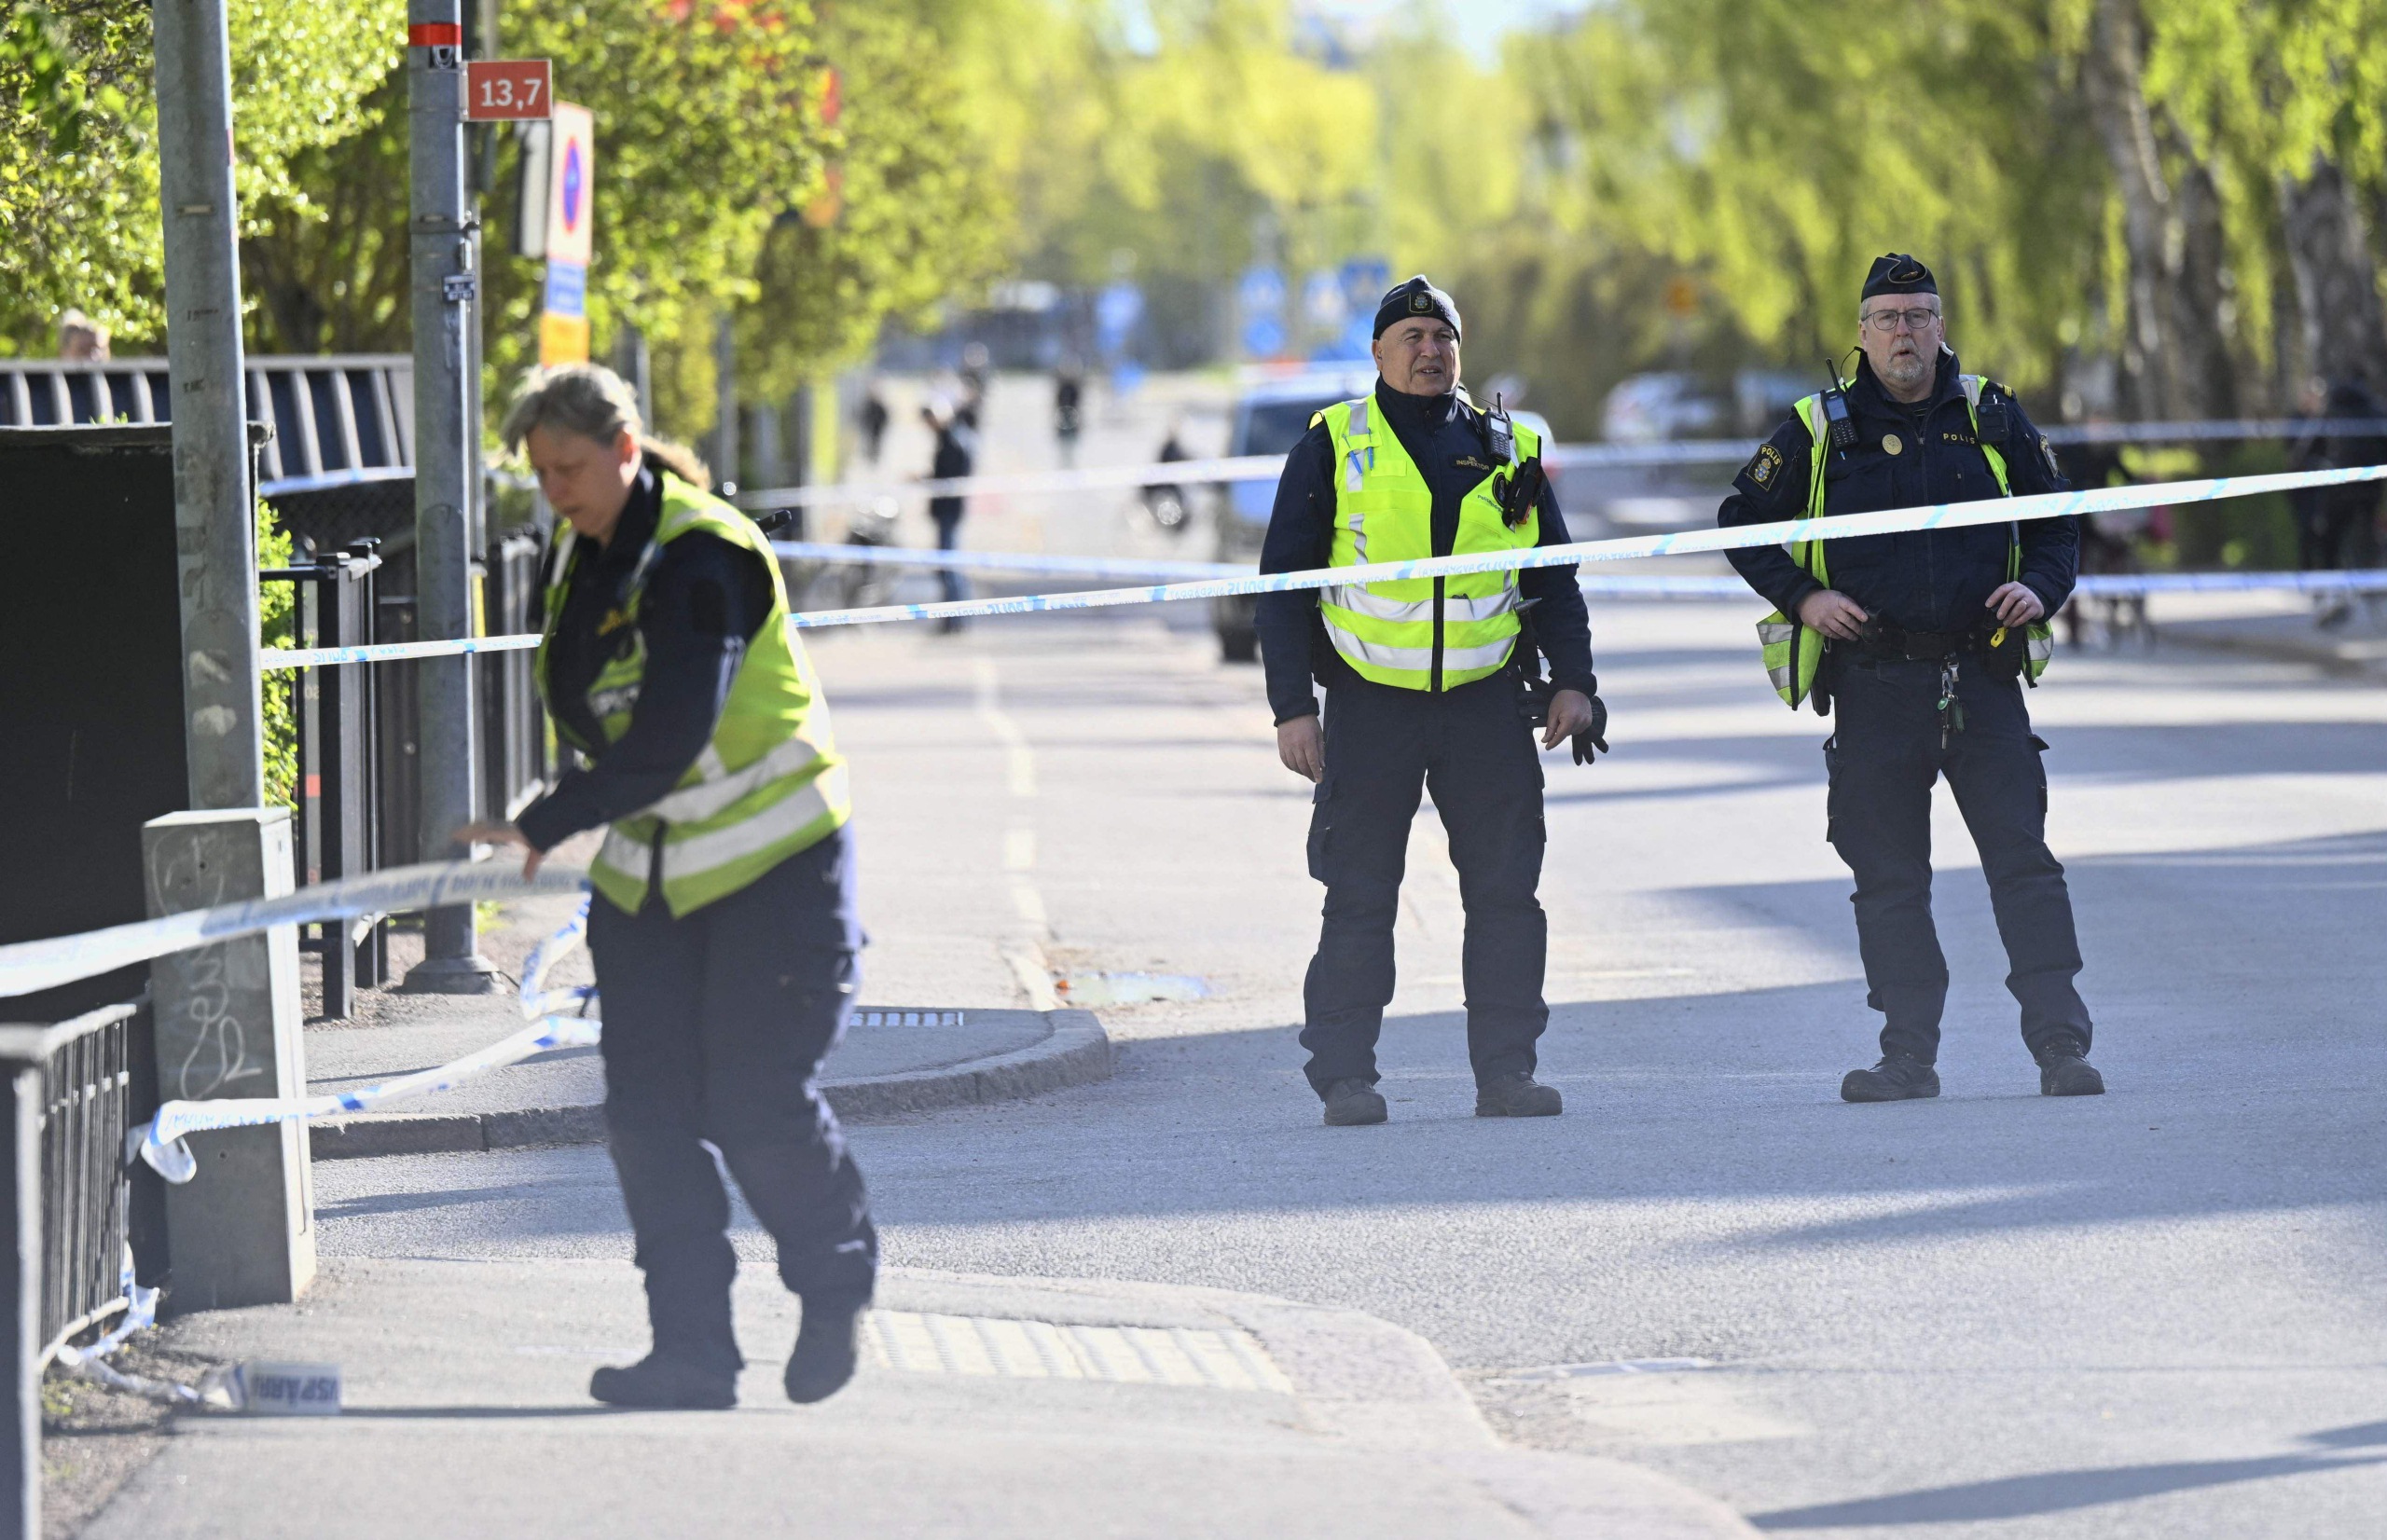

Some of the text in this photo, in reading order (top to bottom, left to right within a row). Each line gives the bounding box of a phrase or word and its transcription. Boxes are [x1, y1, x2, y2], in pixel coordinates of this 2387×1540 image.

[480, 78, 542, 111] 13,7
[1942, 433, 1976, 445] POLIS
[1760, 447, 1781, 465] POLIS
